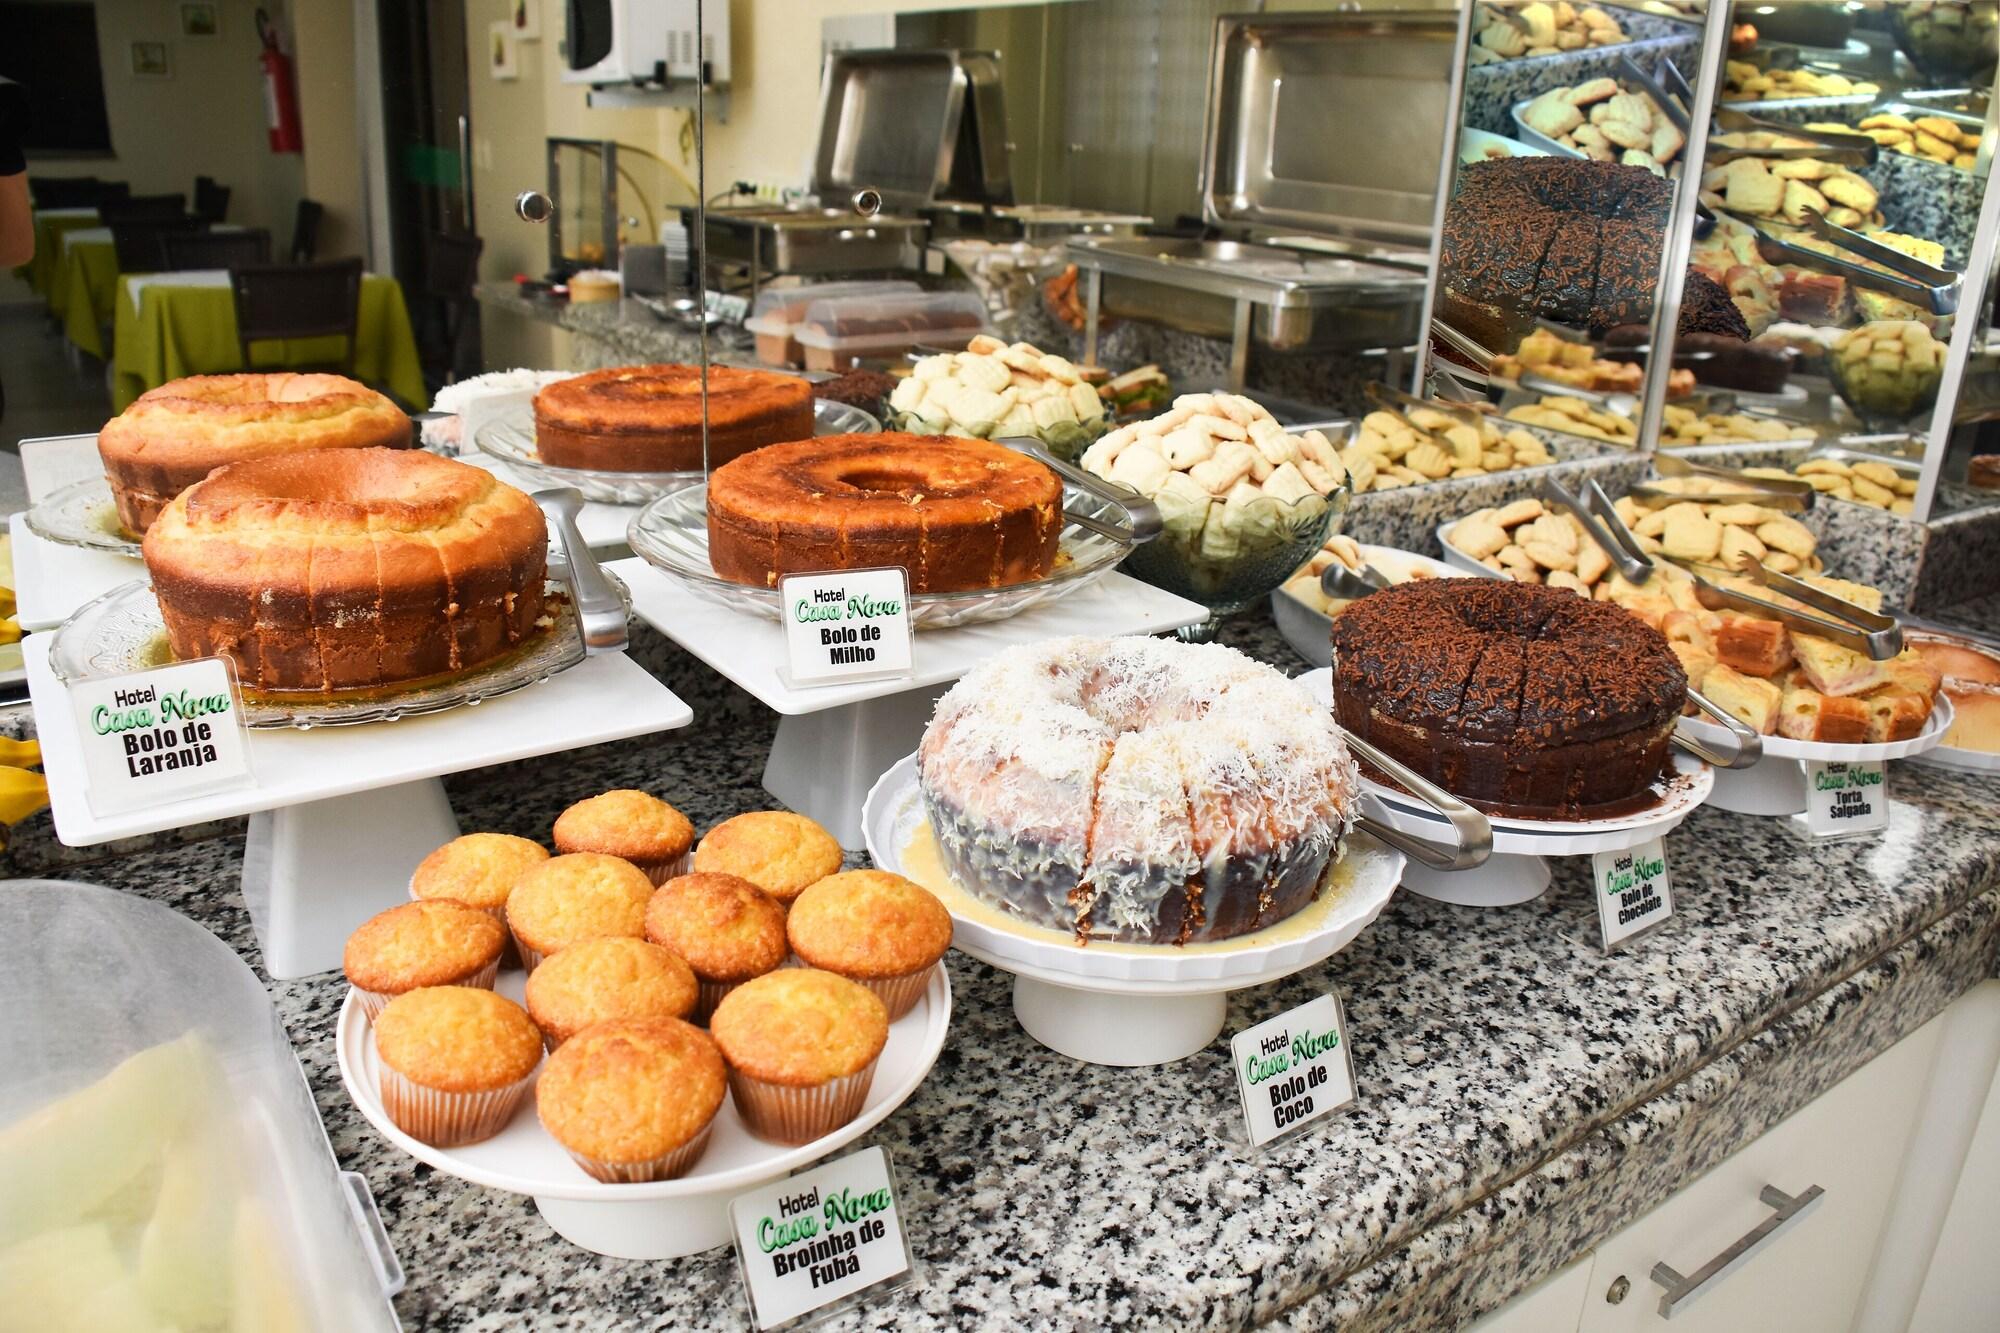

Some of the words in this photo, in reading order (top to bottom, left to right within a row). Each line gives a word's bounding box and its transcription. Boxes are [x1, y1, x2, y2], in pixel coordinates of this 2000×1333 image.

[794, 598, 842, 623] Casa
[847, 593, 901, 619] Nova
[814, 587, 845, 603] Hotel
[820, 626, 857, 645] Bolo
[860, 624, 881, 641] de
[830, 646, 876, 665] Milho
[114, 684, 157, 707] Hotel
[91, 703, 155, 735] Casa
[160, 688, 231, 723] Nova
[123, 728, 178, 756] Bolo
[182, 721, 212, 744] de
[127, 743, 218, 778] Laranja
[1830, 802, 1871, 819] Salgada
[1835, 791, 1863, 805] Torta
[1607, 870, 1633, 895] Casa
[1634, 856, 1664, 884] Nova
[1614, 853, 1633, 873] Hotel
[1618, 896, 1662, 925] Chocolate
[1621, 889, 1641, 908] Bolo
[1642, 883, 1653, 898] de
[1246, 1053, 1289, 1085] Casa
[1292, 1029, 1338, 1066] Nova
[1260, 1029, 1289, 1056] Hotel
[1269, 1074, 1306, 1107] Bolo
[1307, 1065, 1328, 1089] de
[1273, 1095, 1314, 1129] Coco
[778, 1186, 820, 1218] Hotel
[757, 1215, 819, 1253] Casa
[823, 1186, 891, 1231] Nova
[772, 1230, 857, 1278] Broinha
[859, 1219, 885, 1244] de
[809, 1251, 861, 1289] Fubá
